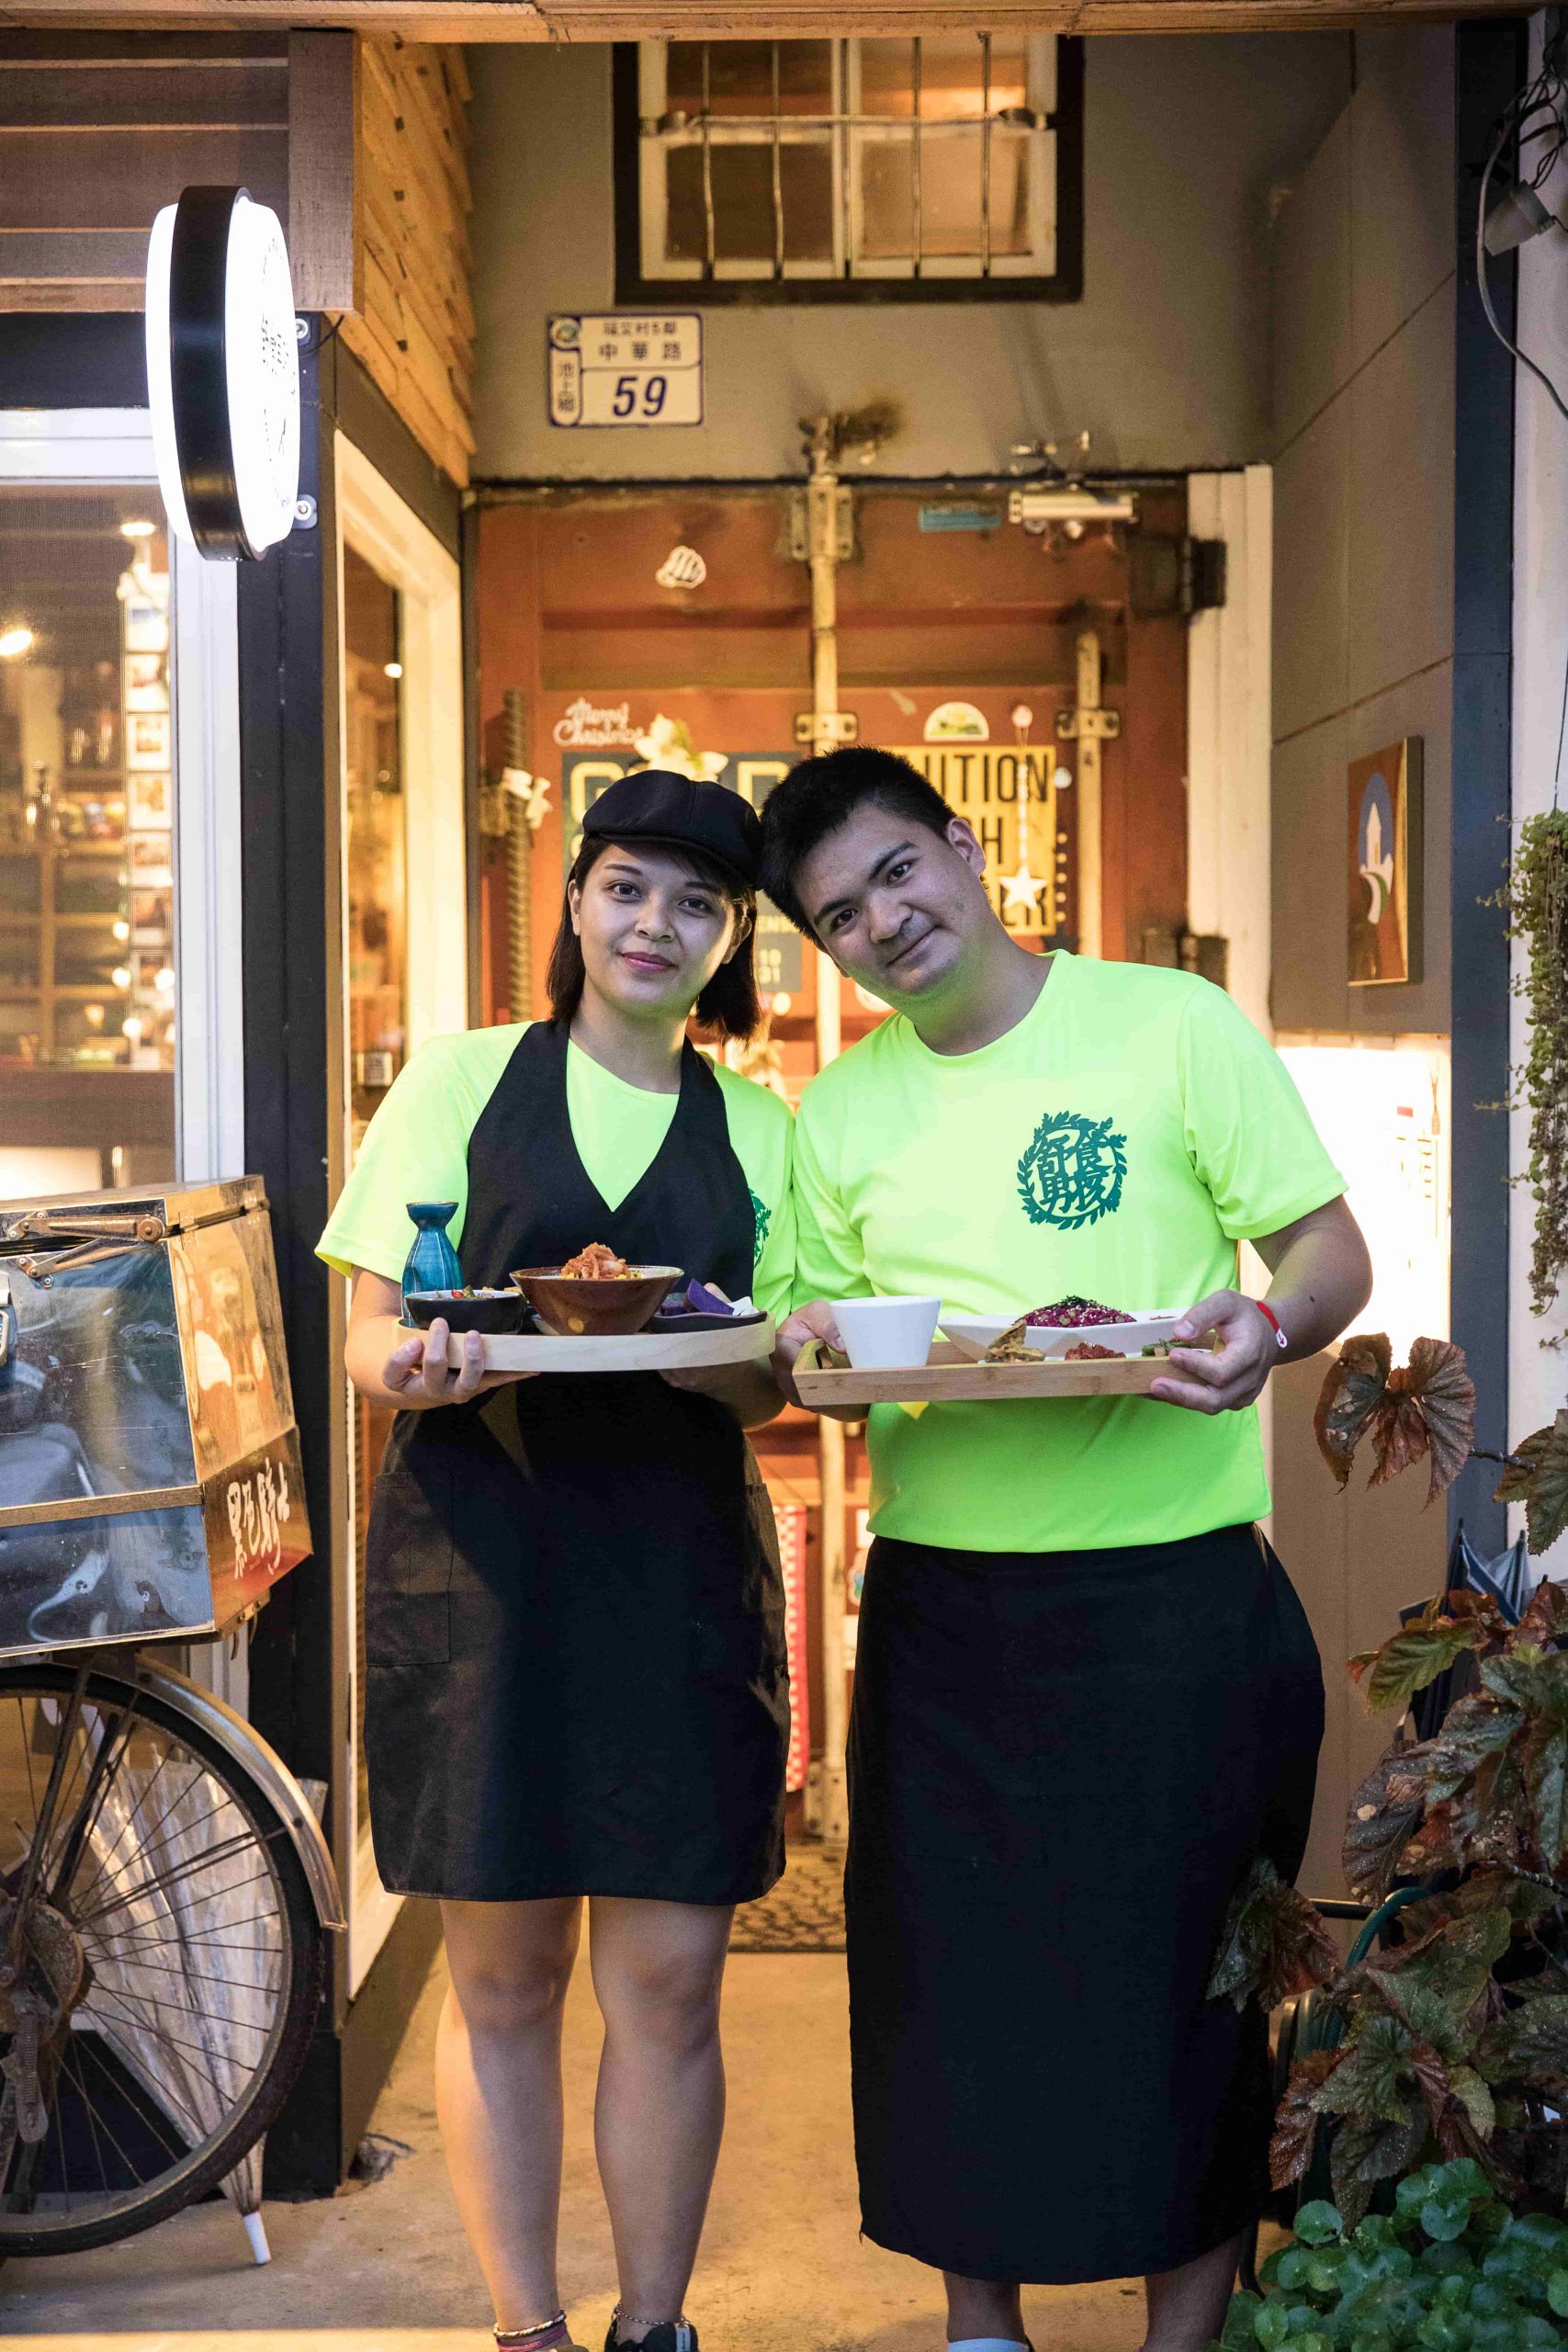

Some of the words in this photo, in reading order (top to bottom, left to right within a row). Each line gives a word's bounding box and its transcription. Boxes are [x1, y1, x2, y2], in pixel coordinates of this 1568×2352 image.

[599, 341, 682, 362] 中華路
[613, 376, 667, 417] 59
[919, 753, 1049, 803] UTION
